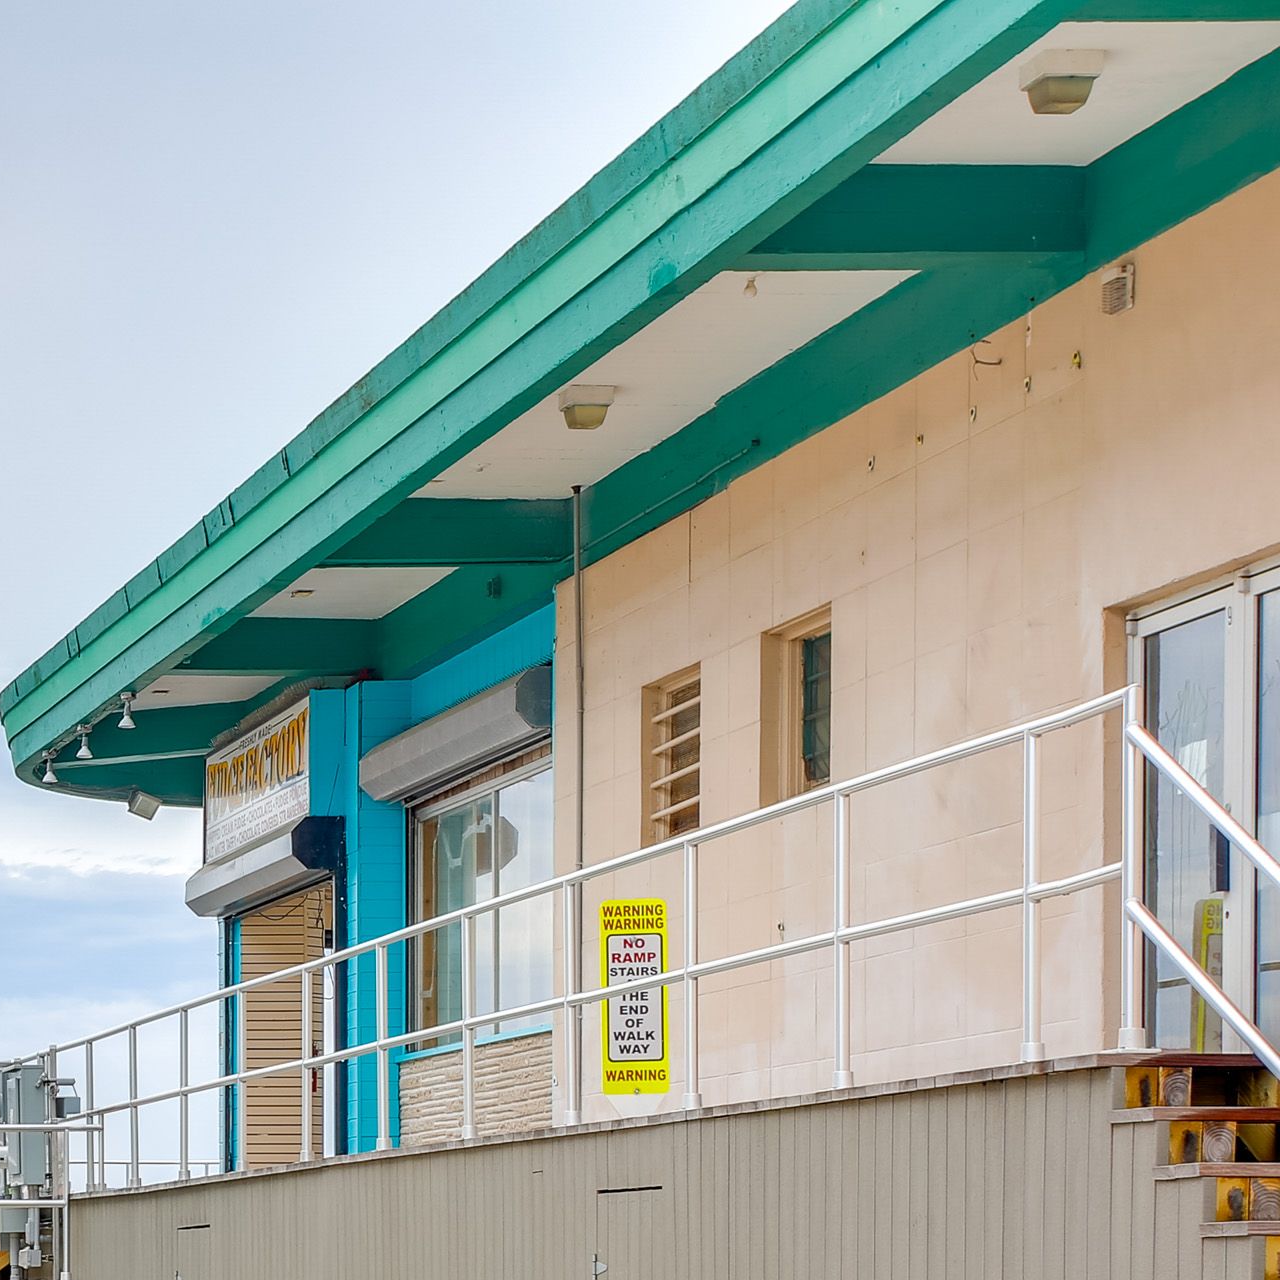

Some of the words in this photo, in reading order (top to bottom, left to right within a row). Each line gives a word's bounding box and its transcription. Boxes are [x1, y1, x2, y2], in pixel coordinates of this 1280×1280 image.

[207, 760, 246, 820] FUDGE
[245, 707, 309, 797] FACTORY
[602, 904, 663, 918] WARNING
[603, 917, 664, 931] WARNING
[623, 938, 645, 949] NO
[611, 952, 656, 964] RAMP
[610, 966, 658, 977] STAIRS
[621, 991, 648, 1001] THE
[620, 1005, 648, 1015] END
[625, 1018, 643, 1028] OF
[613, 1030, 655, 1041] WALK
[619, 1044, 650, 1054] WAY
[606, 1069, 666, 1082] WARNING
